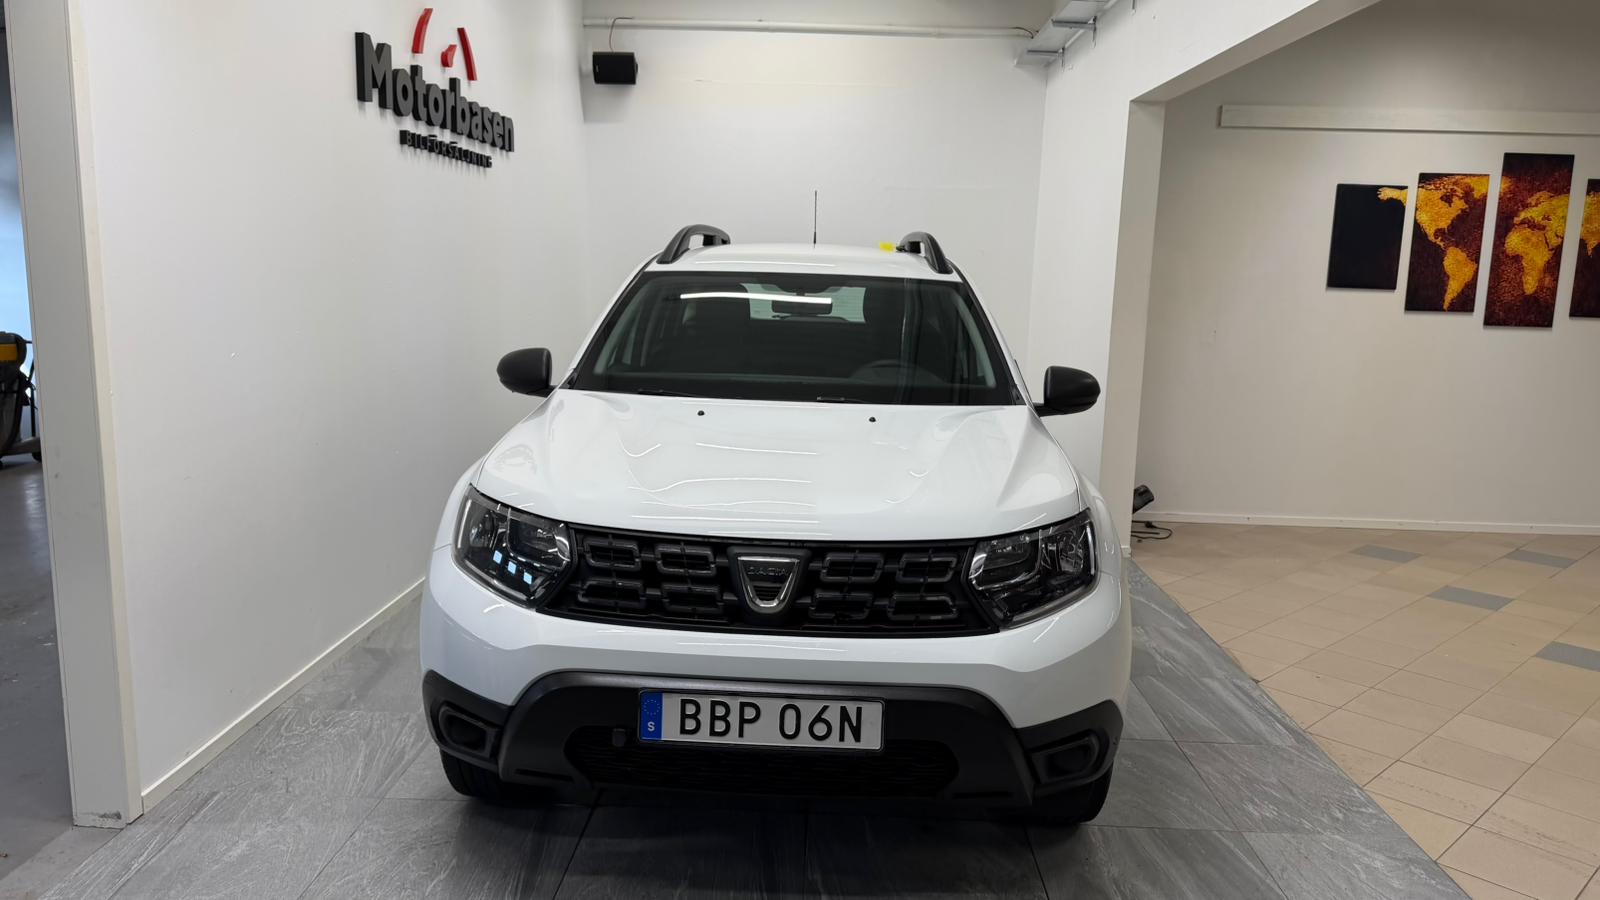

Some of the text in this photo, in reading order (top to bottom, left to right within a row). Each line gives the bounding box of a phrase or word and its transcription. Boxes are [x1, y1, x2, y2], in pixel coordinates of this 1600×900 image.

[355, 32, 514, 152] Motorbasen
[647, 721, 655, 732] S
[679, 698, 862, 743] BBP 06N
